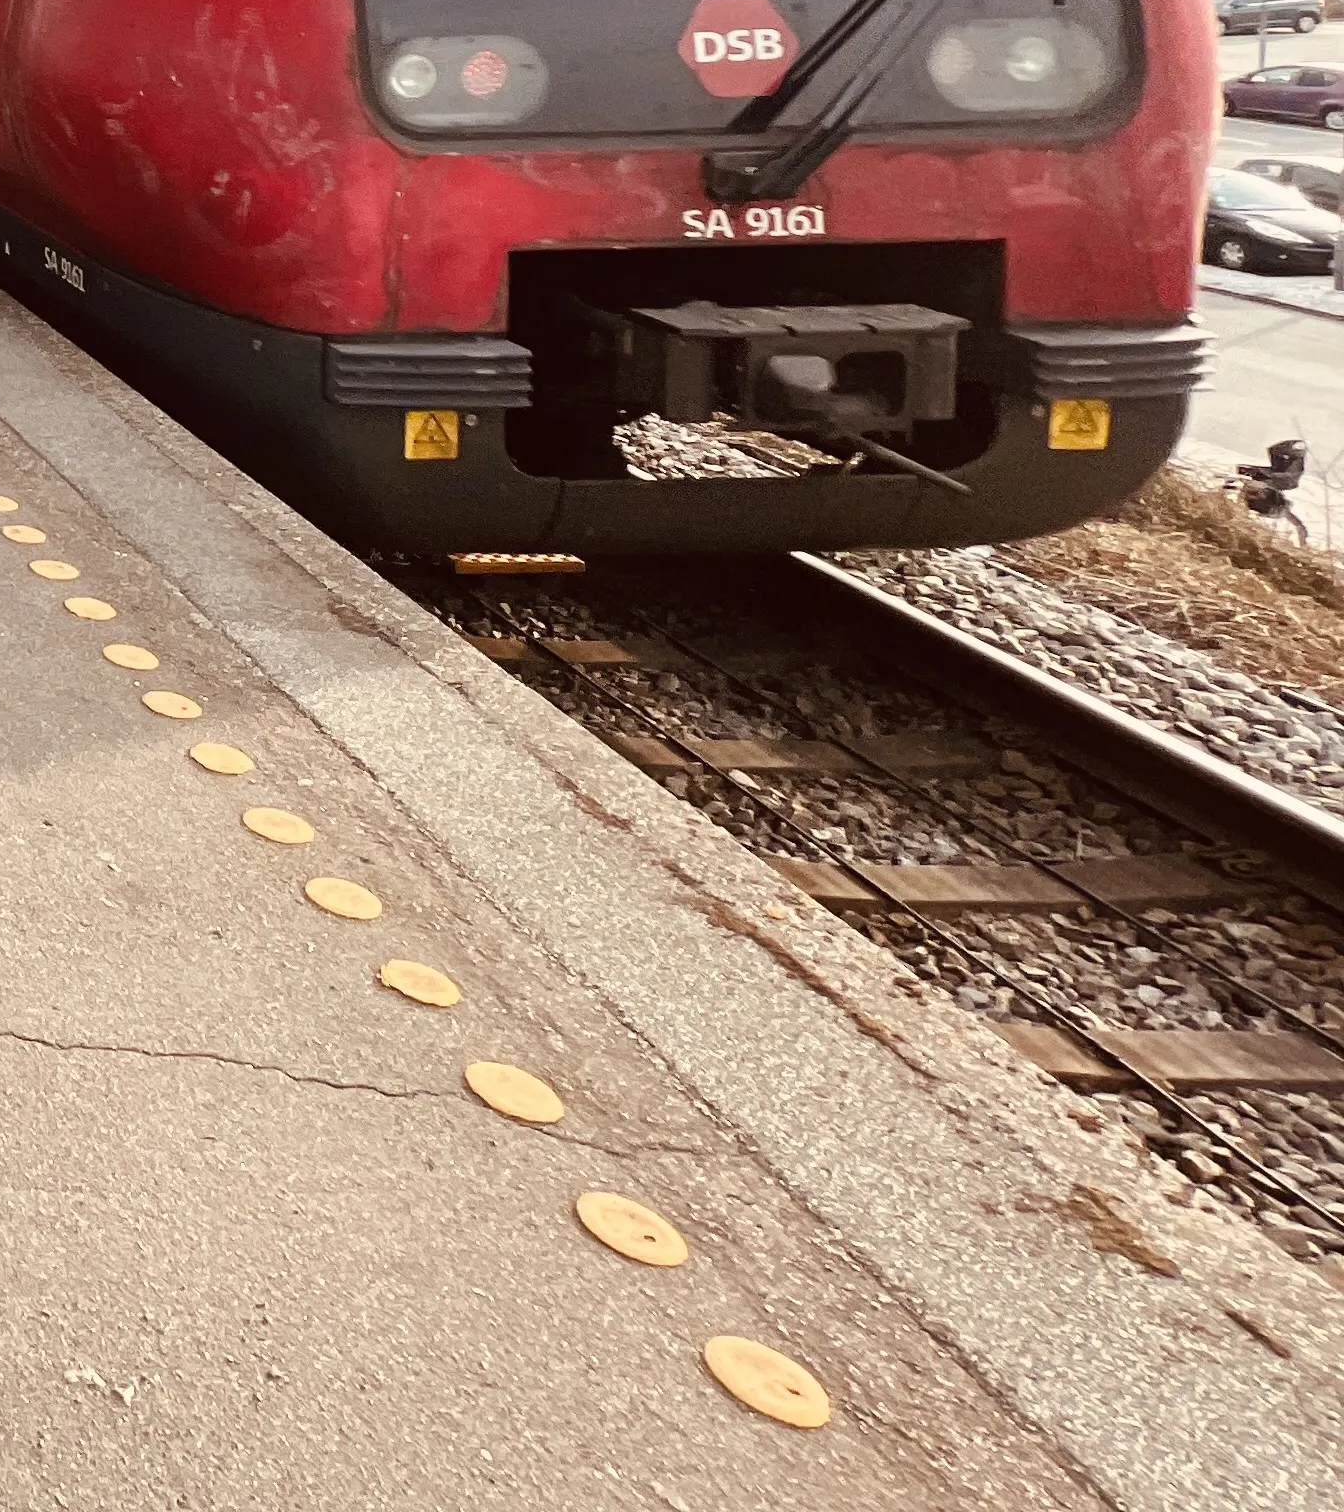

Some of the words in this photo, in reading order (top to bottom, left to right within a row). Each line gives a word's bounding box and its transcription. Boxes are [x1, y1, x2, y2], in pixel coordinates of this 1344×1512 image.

[693, 28, 785, 64] DSB
[681, 208, 735, 239] SA
[744, 204, 827, 237] 9161
[44, 246, 59, 275] SA
[61, 256, 86, 293] 9161
